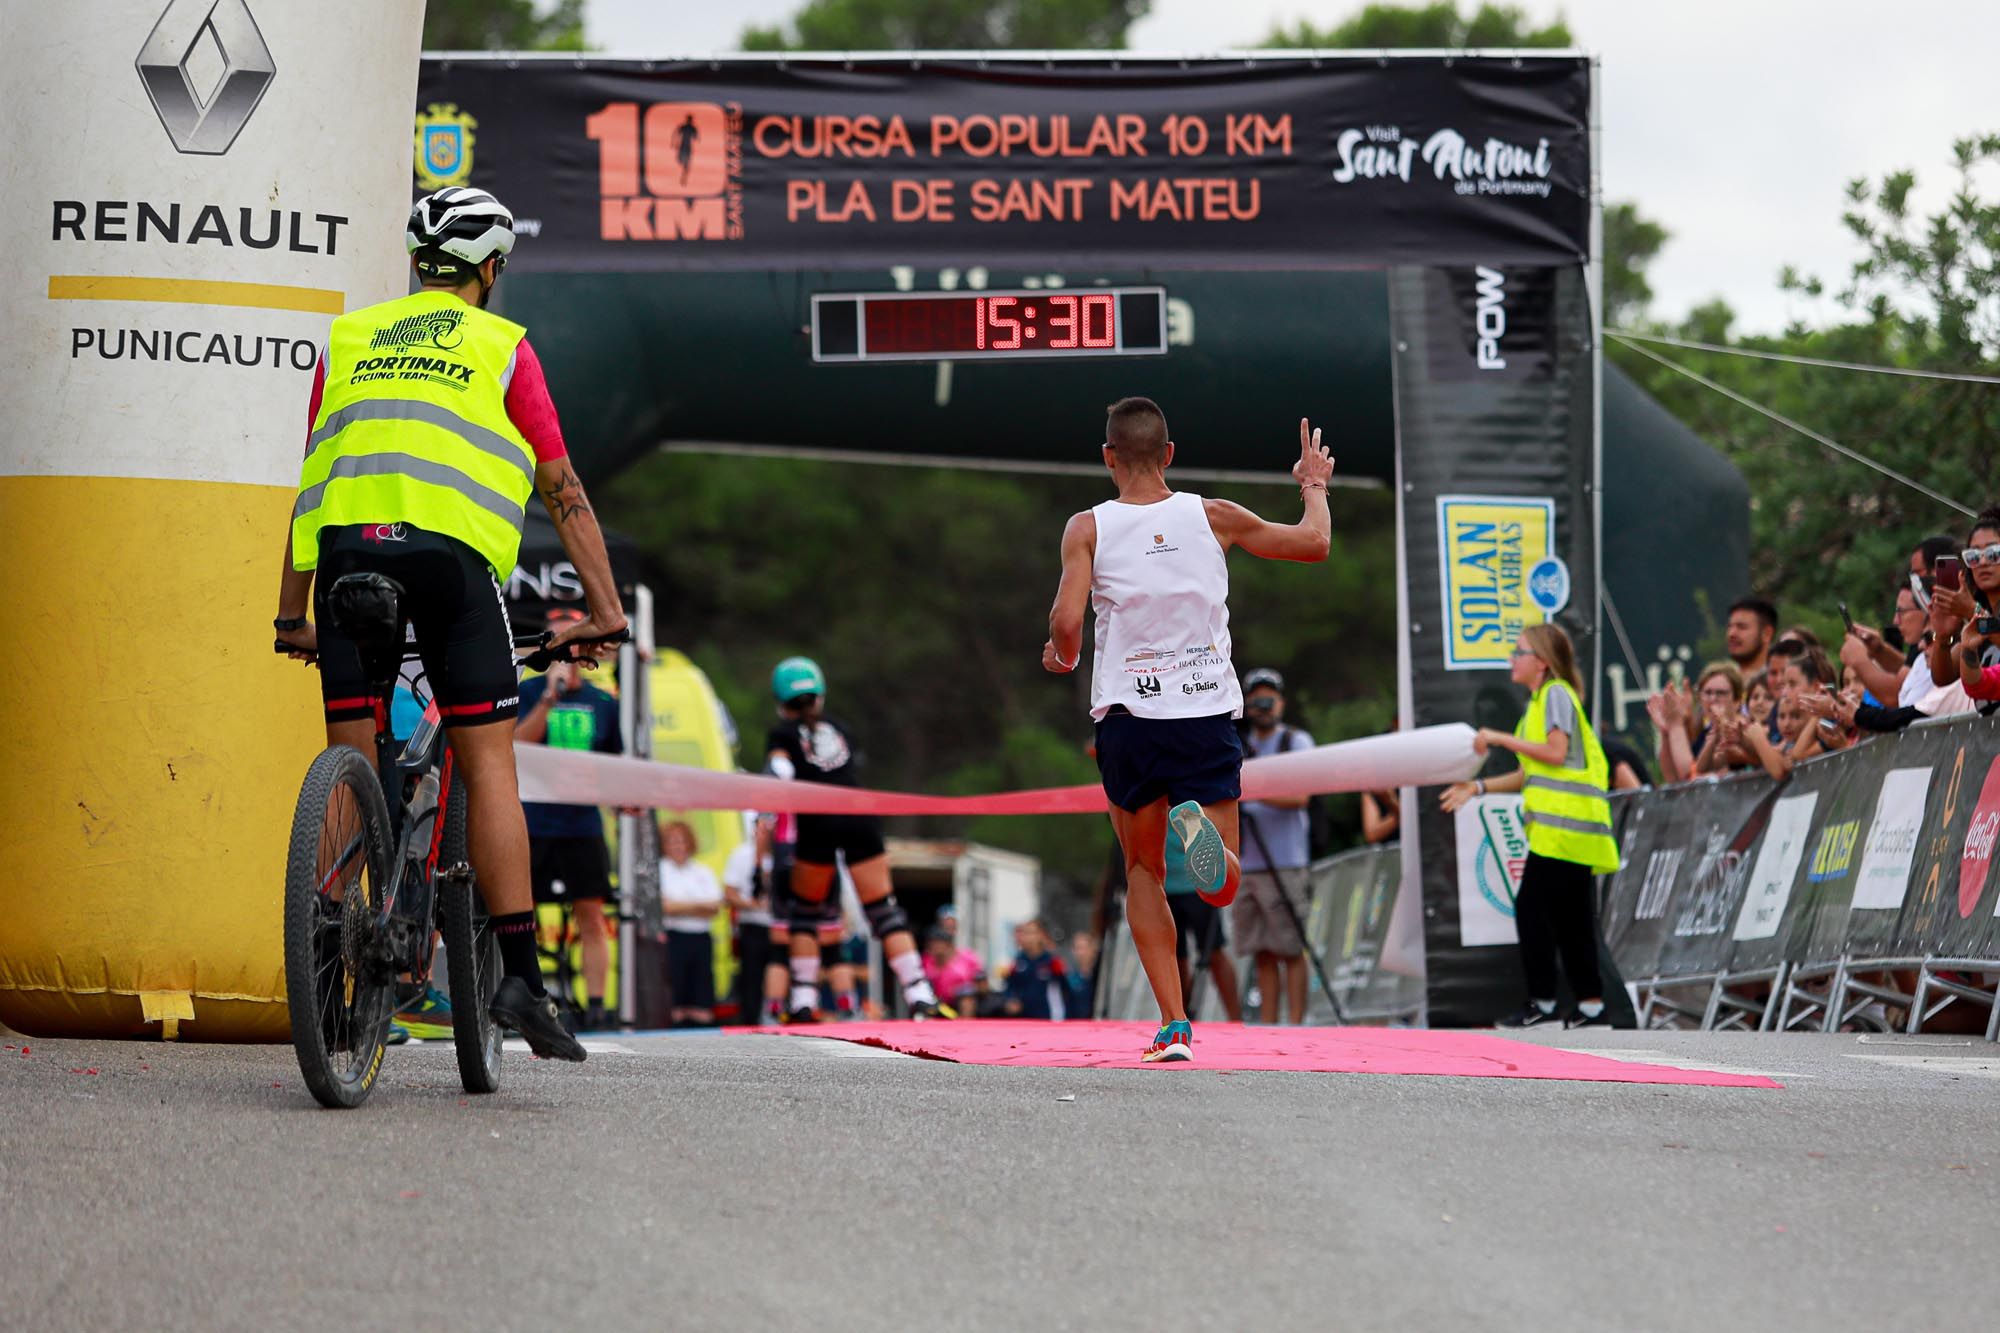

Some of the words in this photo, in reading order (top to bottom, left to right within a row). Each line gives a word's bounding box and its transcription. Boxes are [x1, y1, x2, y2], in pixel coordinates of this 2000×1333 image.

[583, 102, 725, 197] 10
[753, 114, 916, 158] CURSA
[930, 114, 1148, 158] POPULAR
[1160, 114, 1209, 156] 10
[1226, 113, 1292, 156] KM
[1332, 128, 1420, 184] Sant
[1421, 128, 1551, 183] Antoni
[1364, 126, 1400, 142] Visit
[787, 179, 876, 222] PLA
[892, 179, 954, 222] DE
[970, 178, 1093, 222] SANT
[1110, 178, 1261, 221] MATEU
[1454, 180, 1476, 195] de
[1478, 179, 1551, 198] Portmany
[52, 200, 349, 255] RENAULT
[600, 197, 726, 241] KM
[976, 296, 1114, 350] 15:30
[71, 327, 317, 371] PUNICAUTO
[353, 356, 476, 384] PORTINATX
[350, 371, 395, 385] CYCLING
[398, 372, 430, 381] TEAM
[1500, 521, 1524, 608] CABRAS
